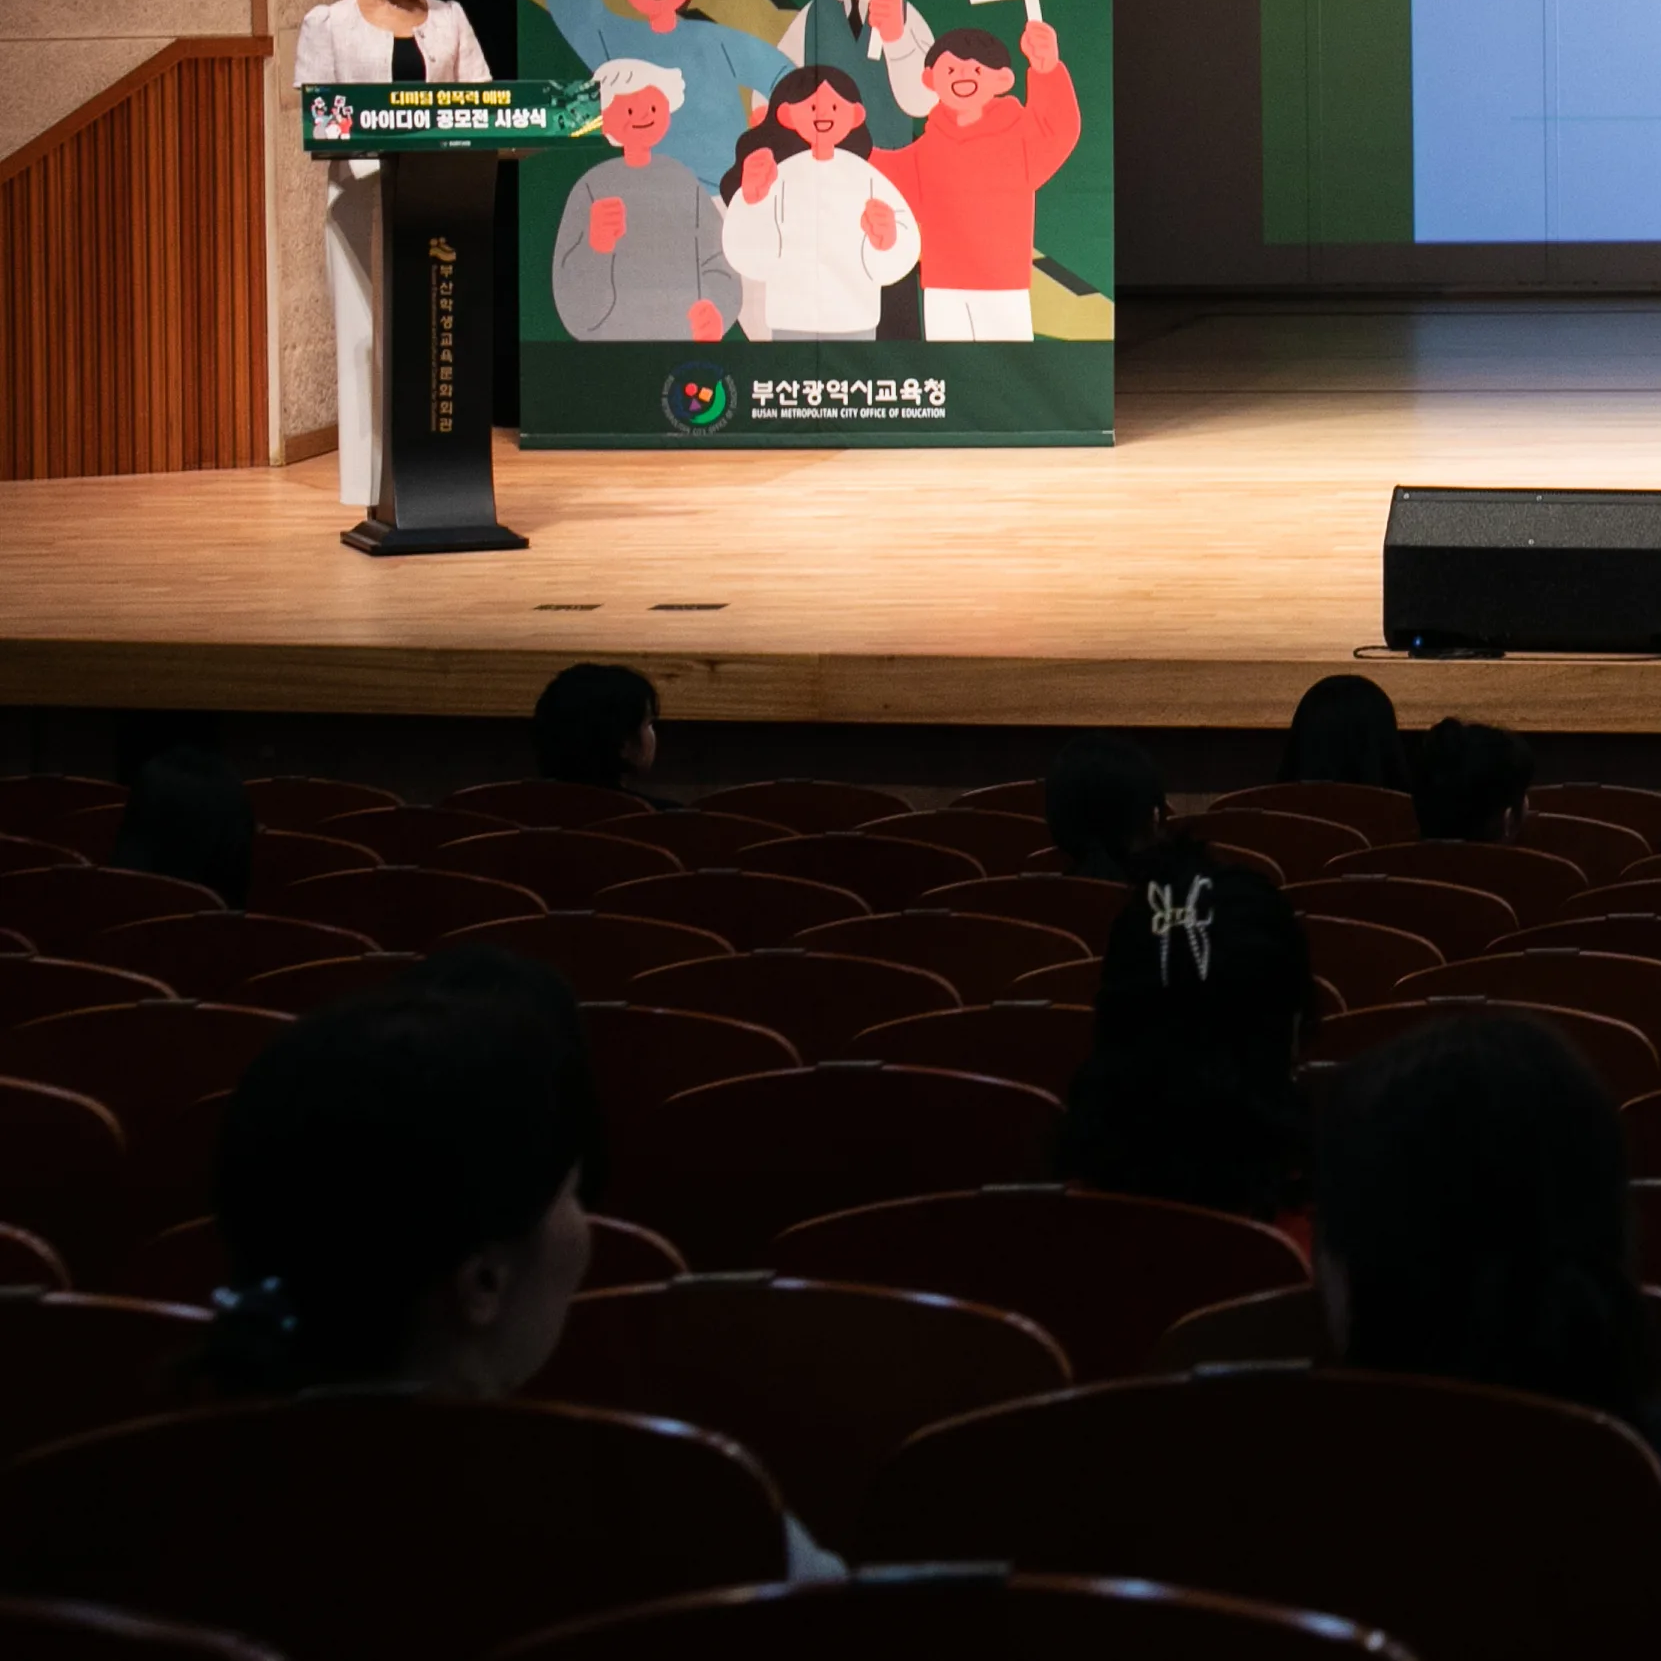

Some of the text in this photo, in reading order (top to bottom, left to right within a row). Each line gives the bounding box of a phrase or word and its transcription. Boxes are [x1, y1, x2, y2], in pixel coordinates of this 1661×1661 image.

[359, 108, 548, 130] 아이디어 공모전 시상식
[752, 376, 946, 406] 부산광역시교육청
[752, 407, 946, 419] BUSAN METROPOLITAN CITY OFFICE OF EDUCATION
